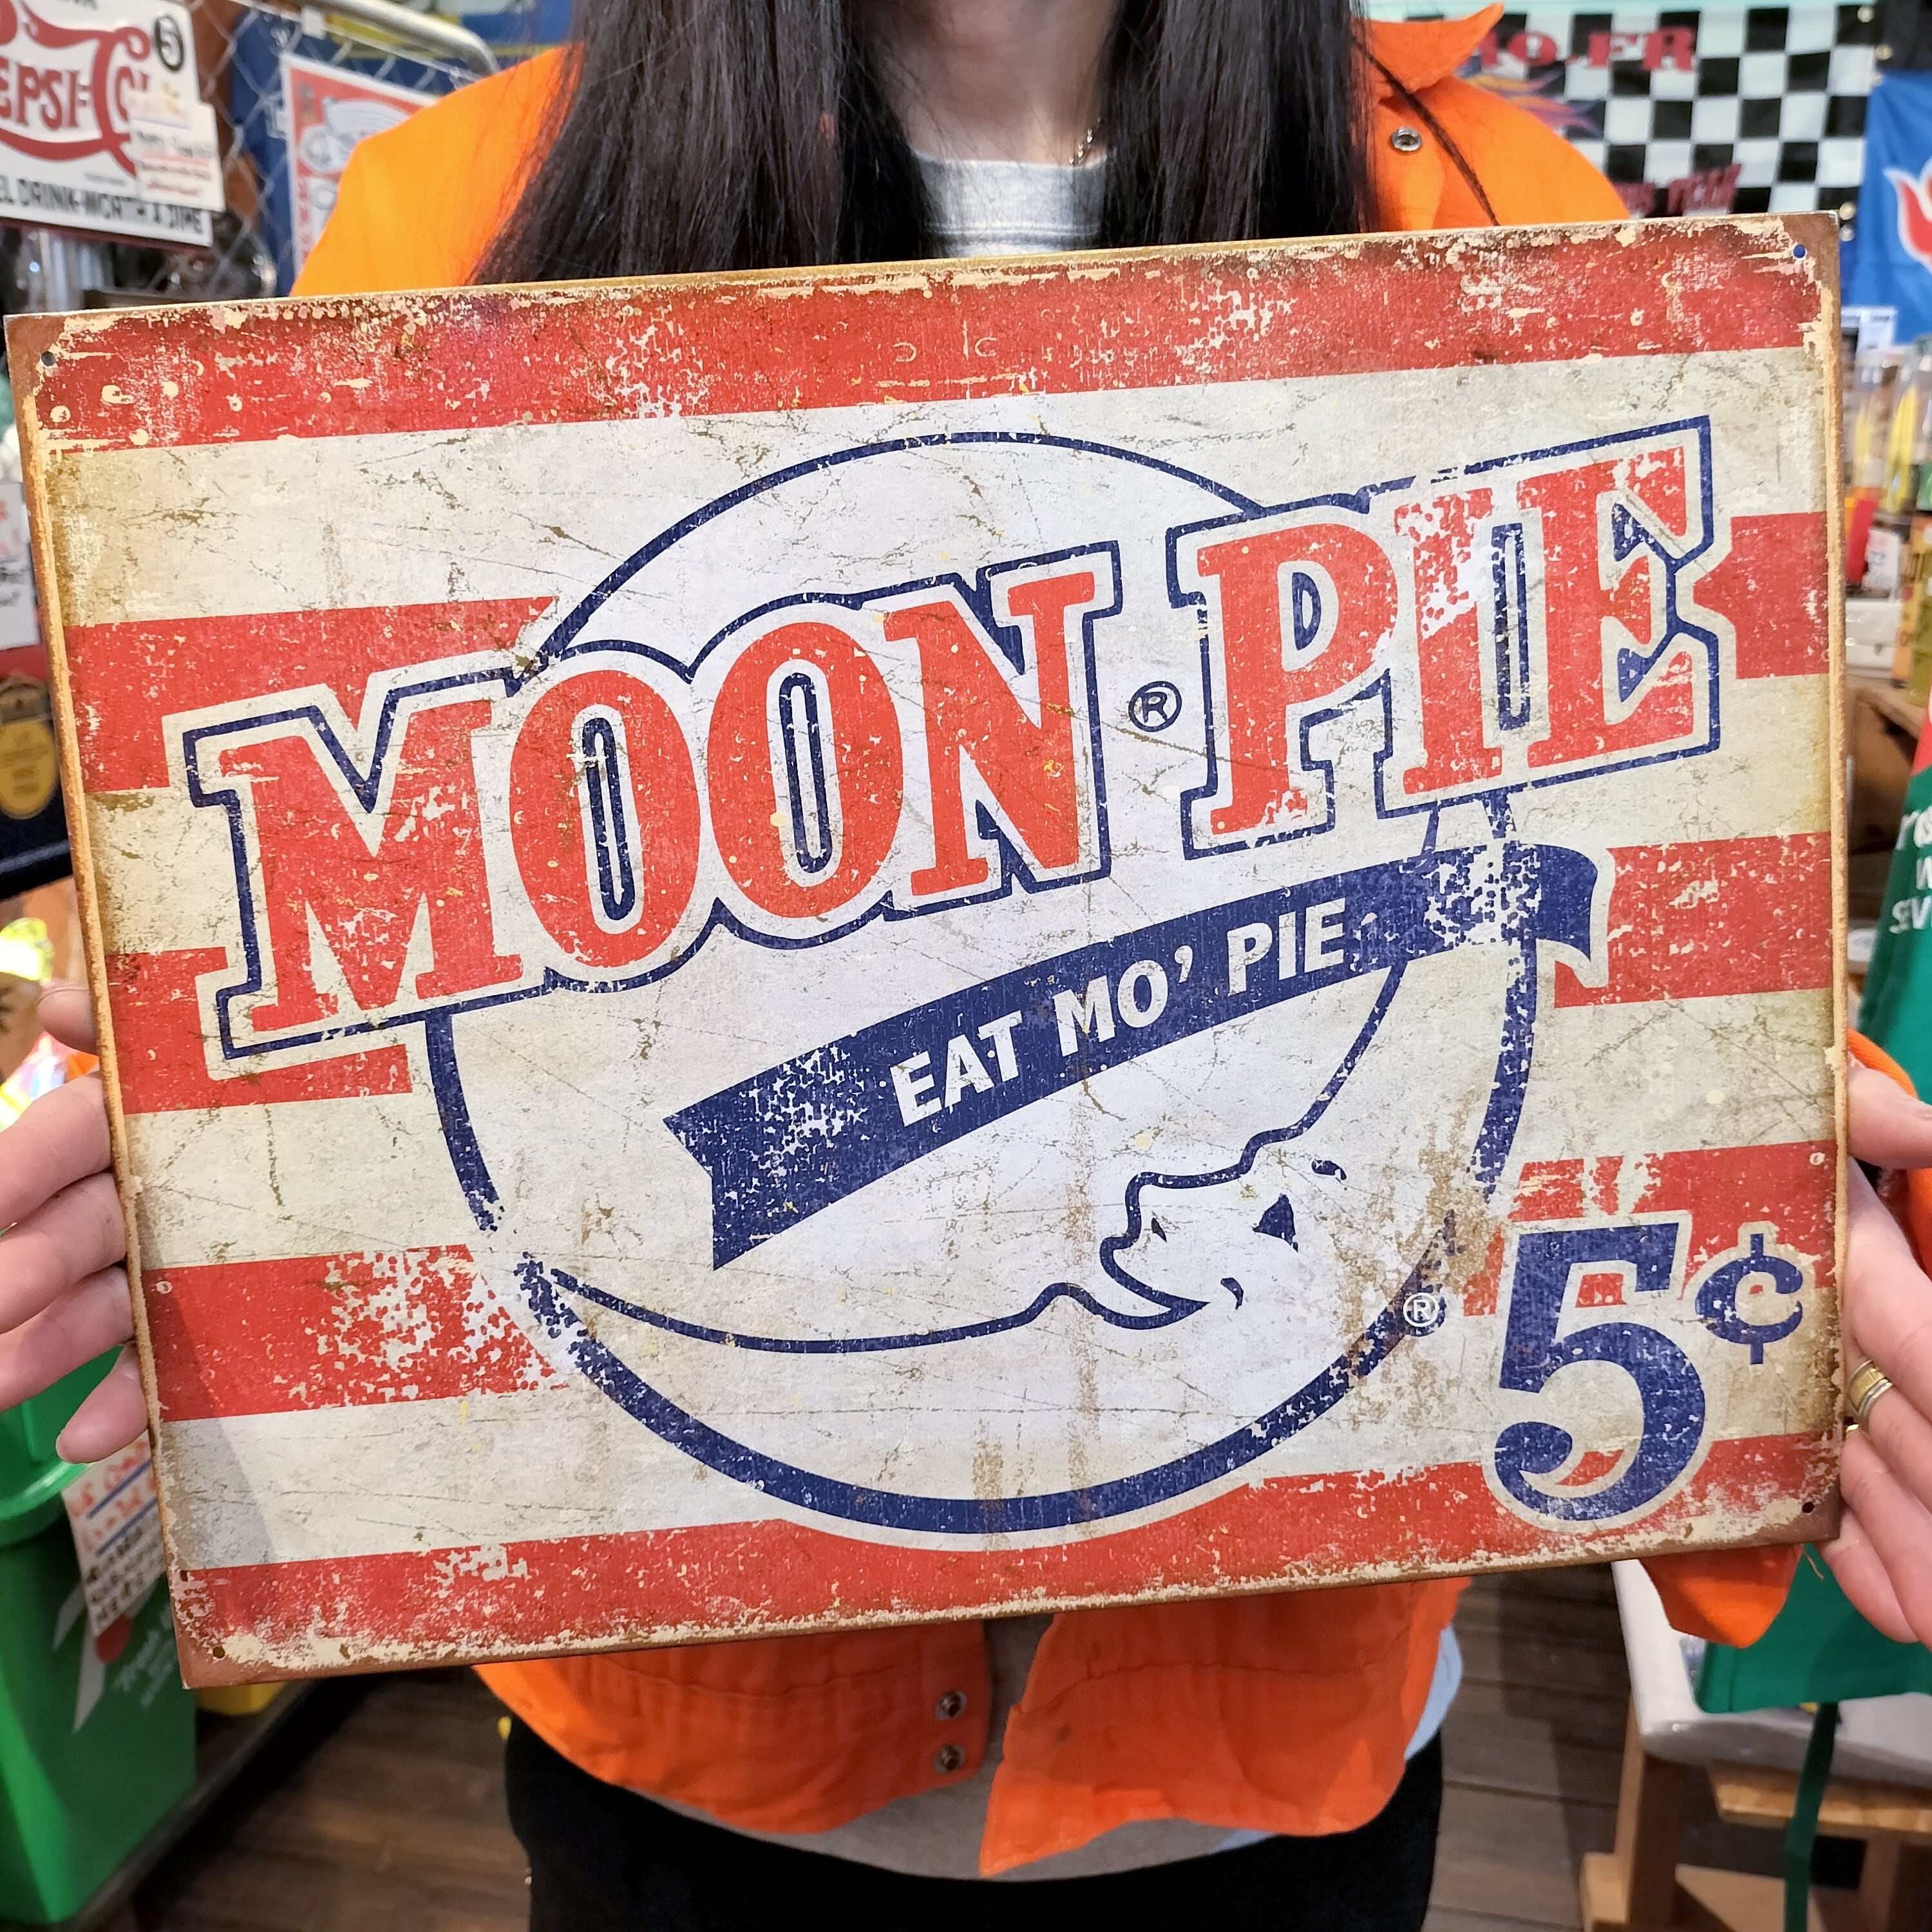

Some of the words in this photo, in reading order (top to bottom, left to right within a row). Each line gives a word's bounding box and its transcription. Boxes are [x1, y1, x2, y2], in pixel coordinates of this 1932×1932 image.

[217, 571, 1095, 1032] MOON
[1196, 446, 1695, 835] PIE
[889, 1010, 1025, 1126] EAT
[1226, 897, 1347, 997] PIE
